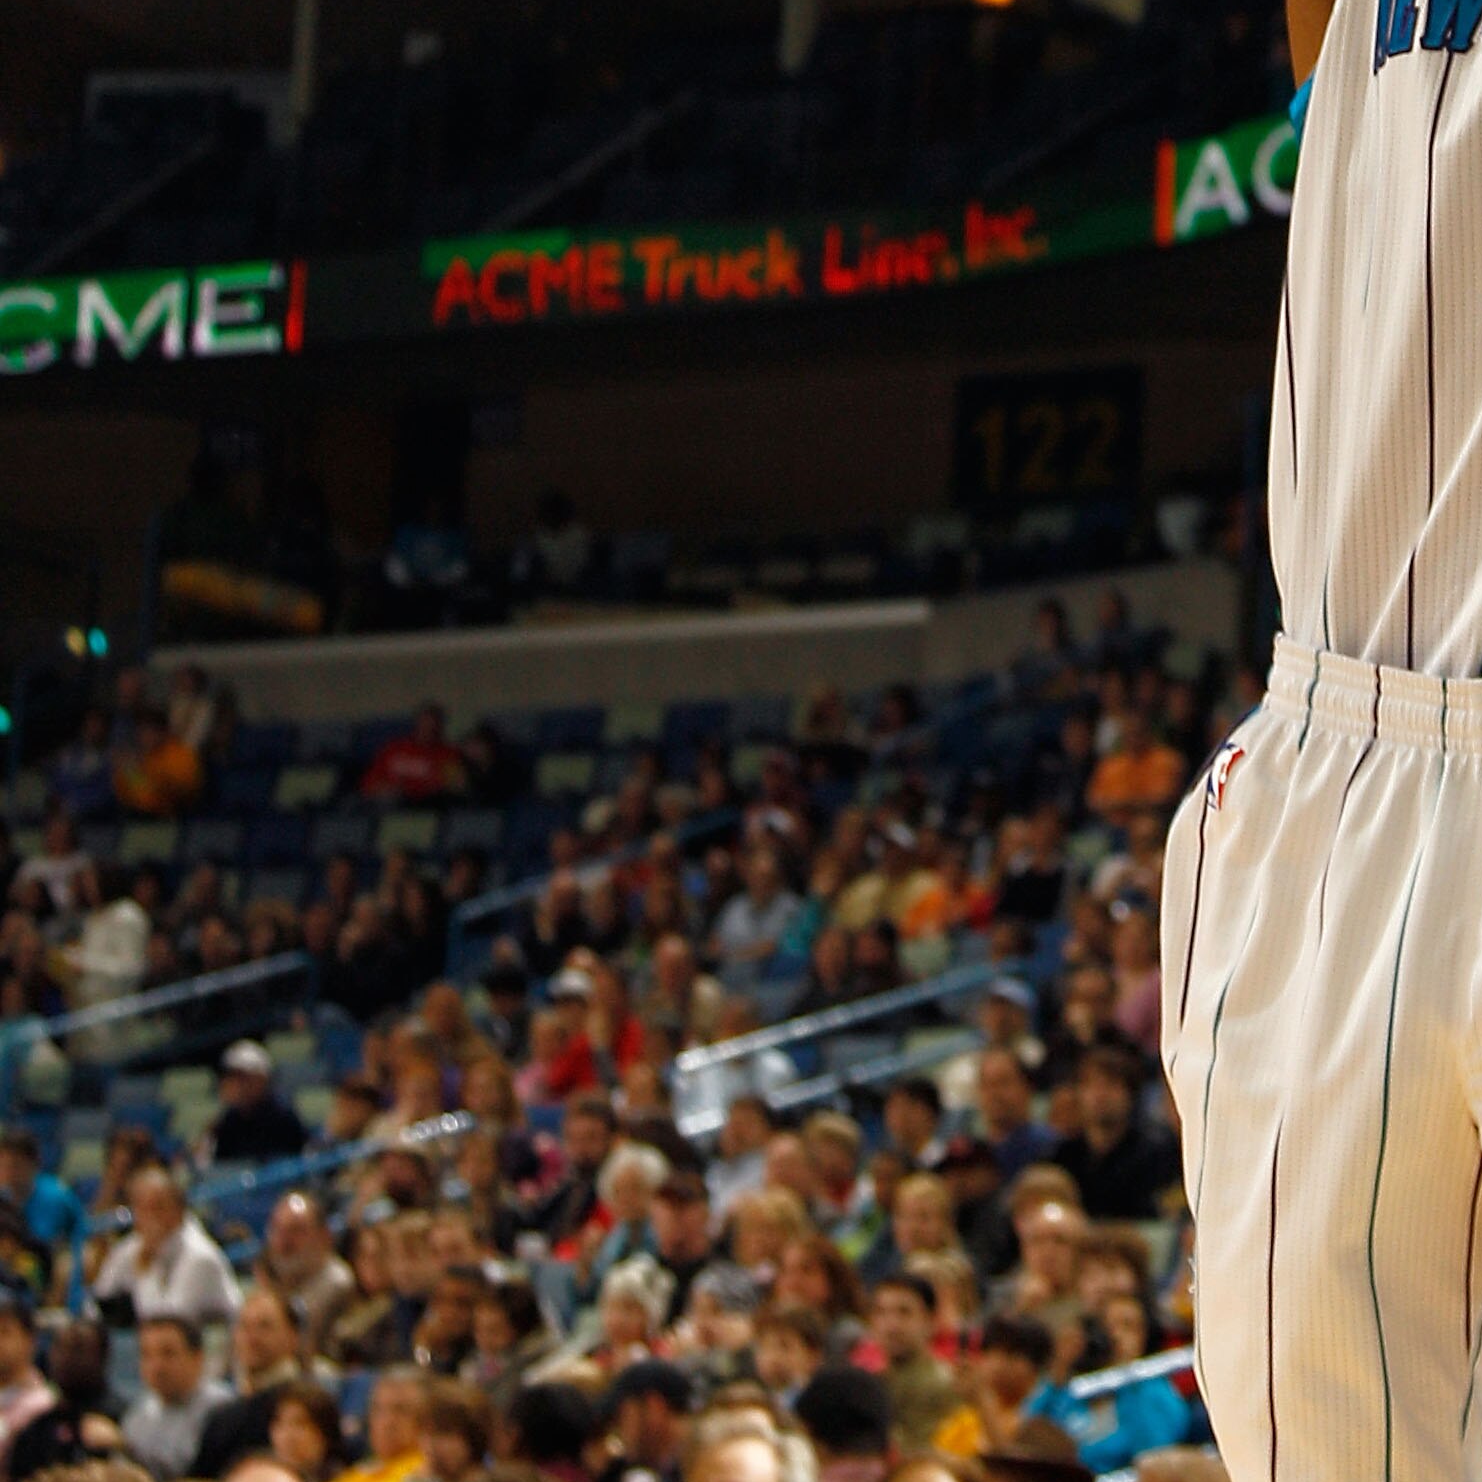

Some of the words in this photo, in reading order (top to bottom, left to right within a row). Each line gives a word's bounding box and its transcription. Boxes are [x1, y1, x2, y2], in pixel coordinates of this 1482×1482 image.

[433, 240, 625, 326] ACME
[632, 227, 804, 305] Truck
[972, 396, 1124, 496] 122
